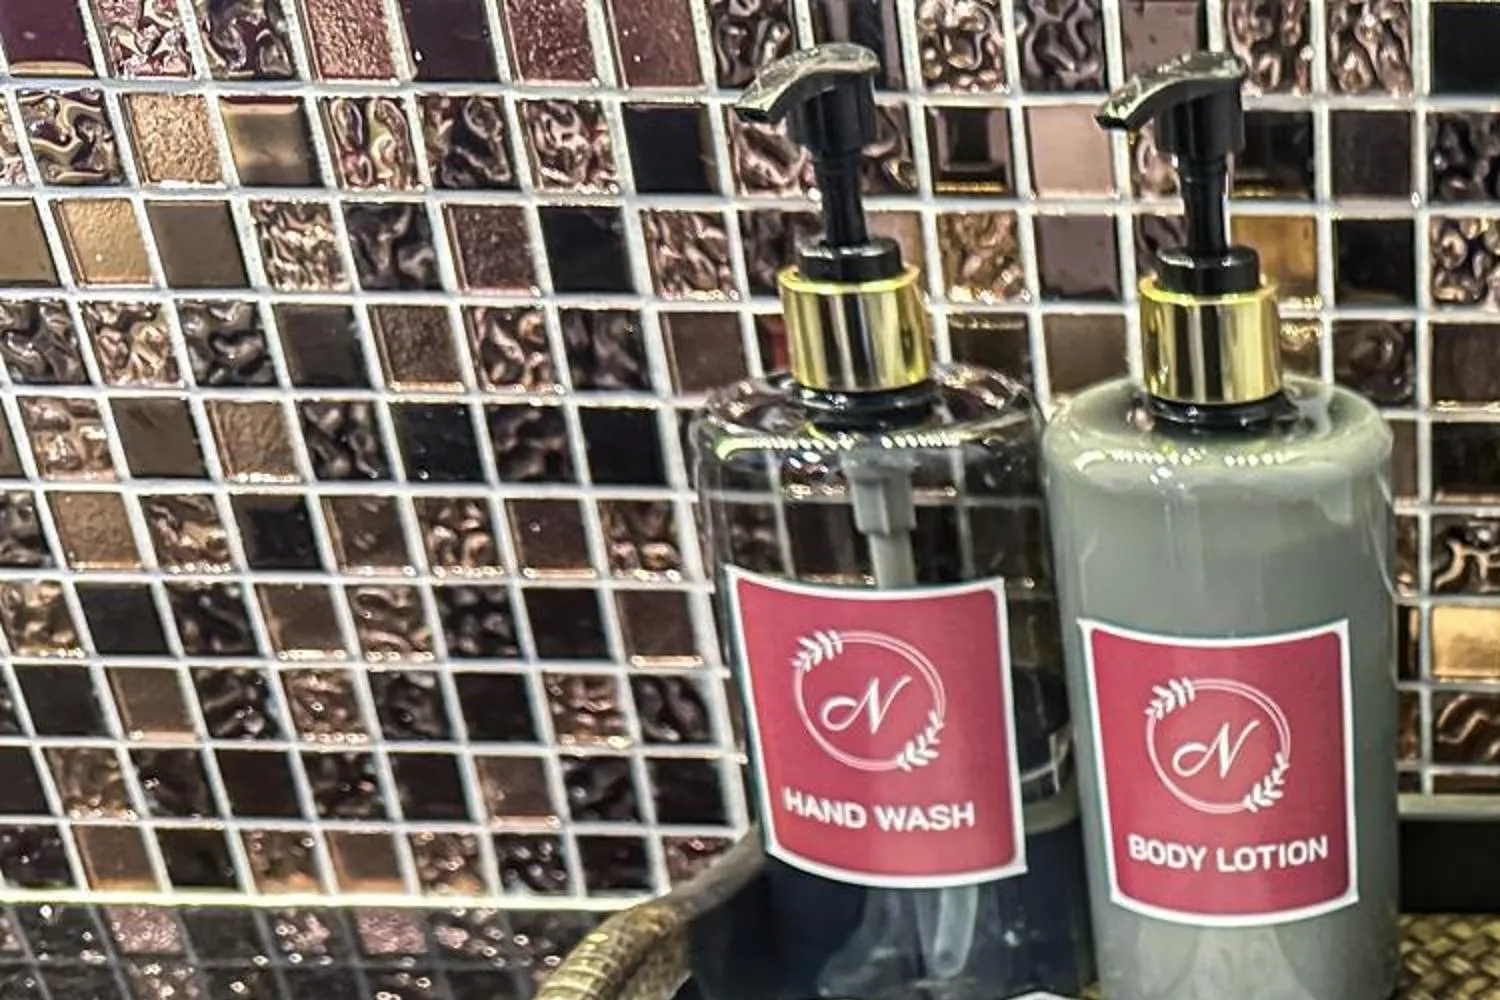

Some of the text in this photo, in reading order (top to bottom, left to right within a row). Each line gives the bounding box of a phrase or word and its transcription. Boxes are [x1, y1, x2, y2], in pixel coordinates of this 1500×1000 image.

[782, 786, 975, 832] HAND WASH
[1127, 833, 1329, 873] BODY LOTION
